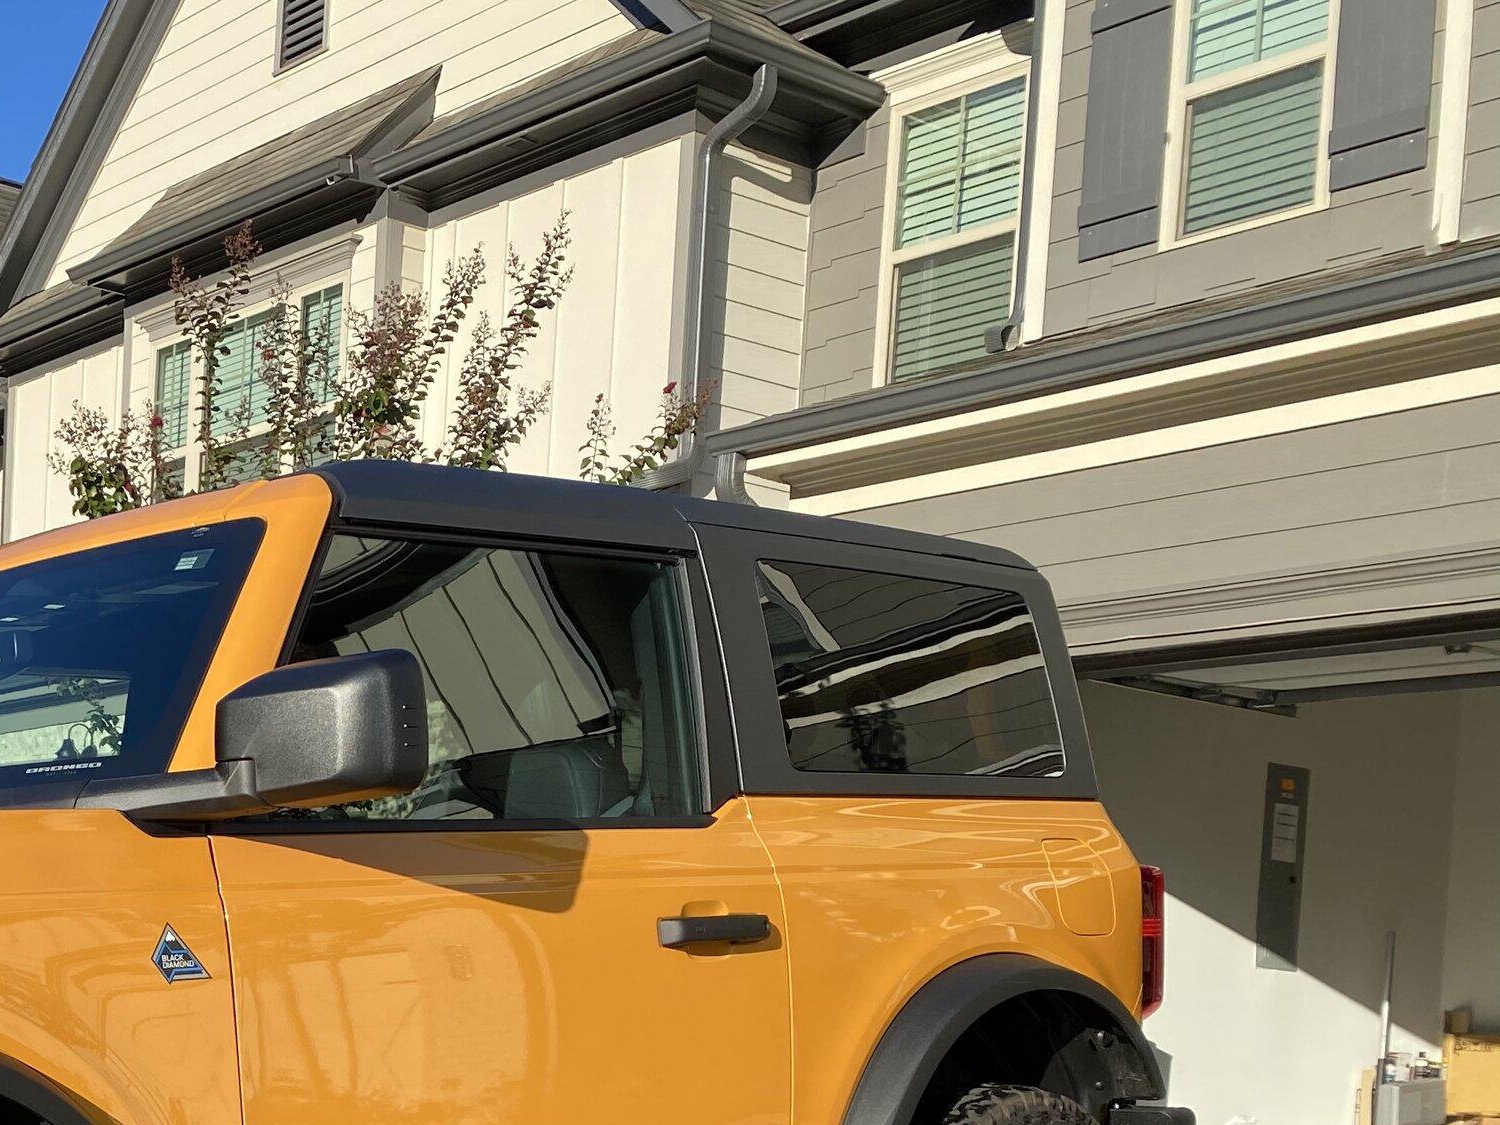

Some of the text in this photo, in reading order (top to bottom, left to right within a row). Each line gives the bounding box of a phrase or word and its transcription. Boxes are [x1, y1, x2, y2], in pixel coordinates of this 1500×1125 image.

[26, 762, 102, 774] BRONCO
[161, 953, 184, 961] BLACK
[162, 960, 195, 969] DIAMOND
